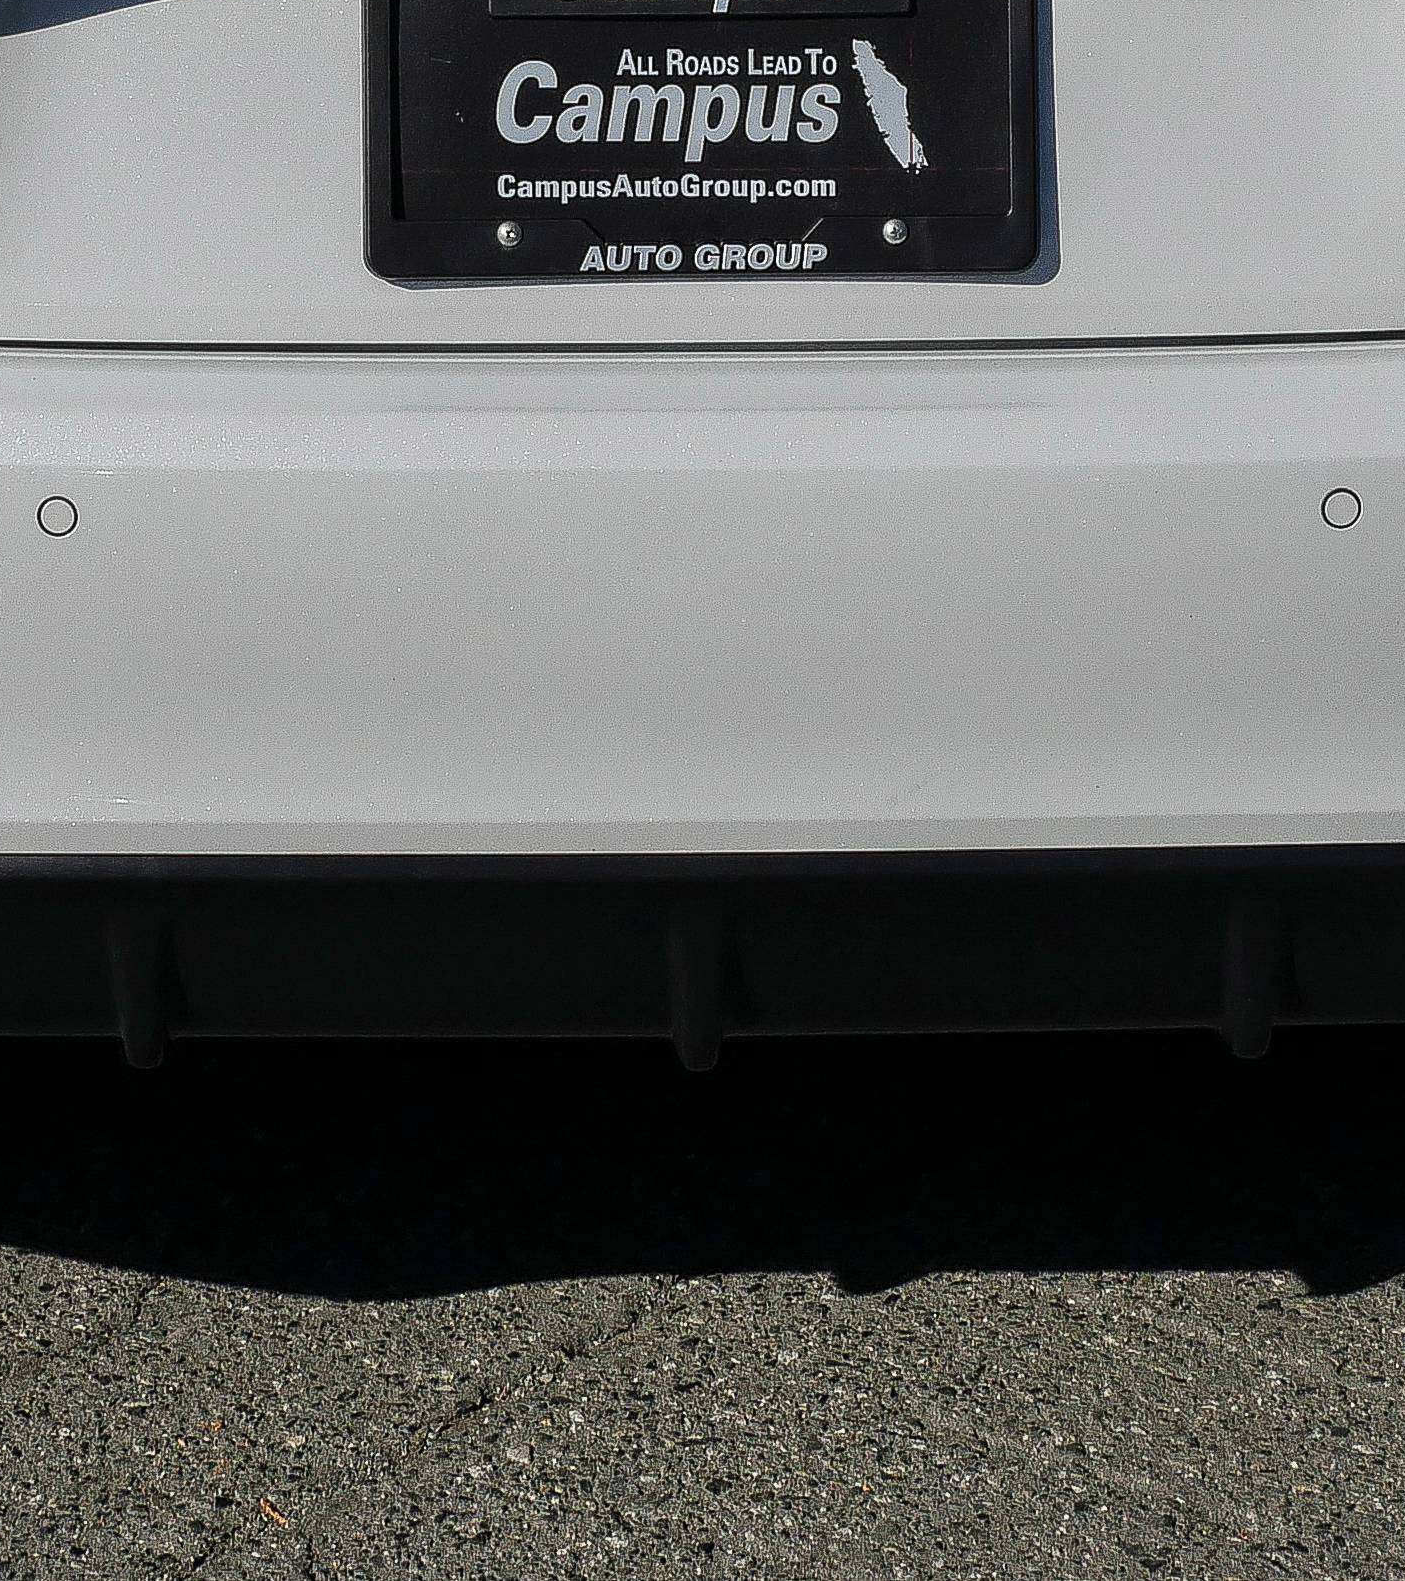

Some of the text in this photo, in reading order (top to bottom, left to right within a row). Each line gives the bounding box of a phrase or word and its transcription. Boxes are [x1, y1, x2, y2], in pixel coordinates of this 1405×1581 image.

[494, 59, 843, 163] Campus
[496, 173, 838, 204] CampusAutoGroup.com
[579, 241, 829, 272] AUTO GROUP
